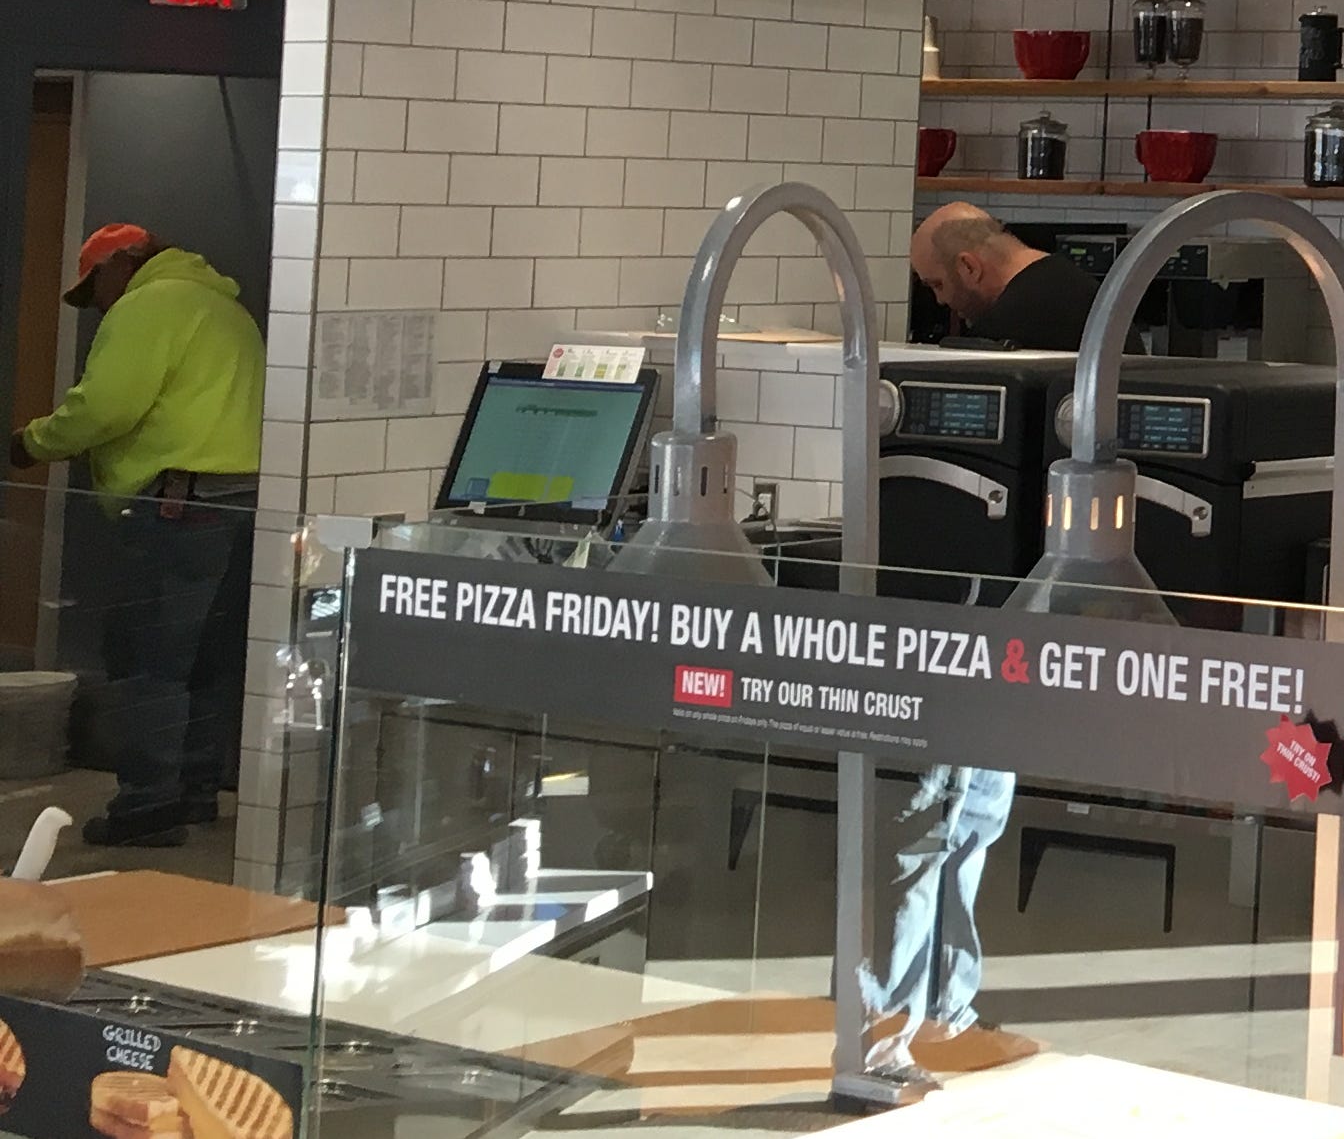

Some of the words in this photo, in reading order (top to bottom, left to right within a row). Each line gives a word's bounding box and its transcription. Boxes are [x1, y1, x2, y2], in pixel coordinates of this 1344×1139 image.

[380, 574, 448, 620] FREE
[456, 581, 536, 630] PIZZA
[545, 591, 660, 643] FRIDAY!
[670, 604, 733, 650] BUY
[740, 612, 764, 654] A
[773, 614, 886, 668] WHOLE
[897, 627, 992, 679] PIZZA
[1000, 638, 1030, 684] &
[1039, 641, 1106, 691] GET
[1116, 649, 1189, 702] ONE
[1199, 658, 1305, 714] FREE!
[682, 670, 726, 698] NEW!
[741, 677, 774, 704] TRY
[778, 681, 813, 709] OUR
[818, 686, 860, 714] THIN
[864, 691, 923, 721] CRUST
[1277, 742, 1294, 761] THIN
[1294, 757, 1320, 783] CRUST!
[1290, 740, 1305, 756] TRY
[1304, 752, 1316, 767] ON
[102, 1025, 161, 1052] GRILLED
[106, 1045, 154, 1071] CHEESE
